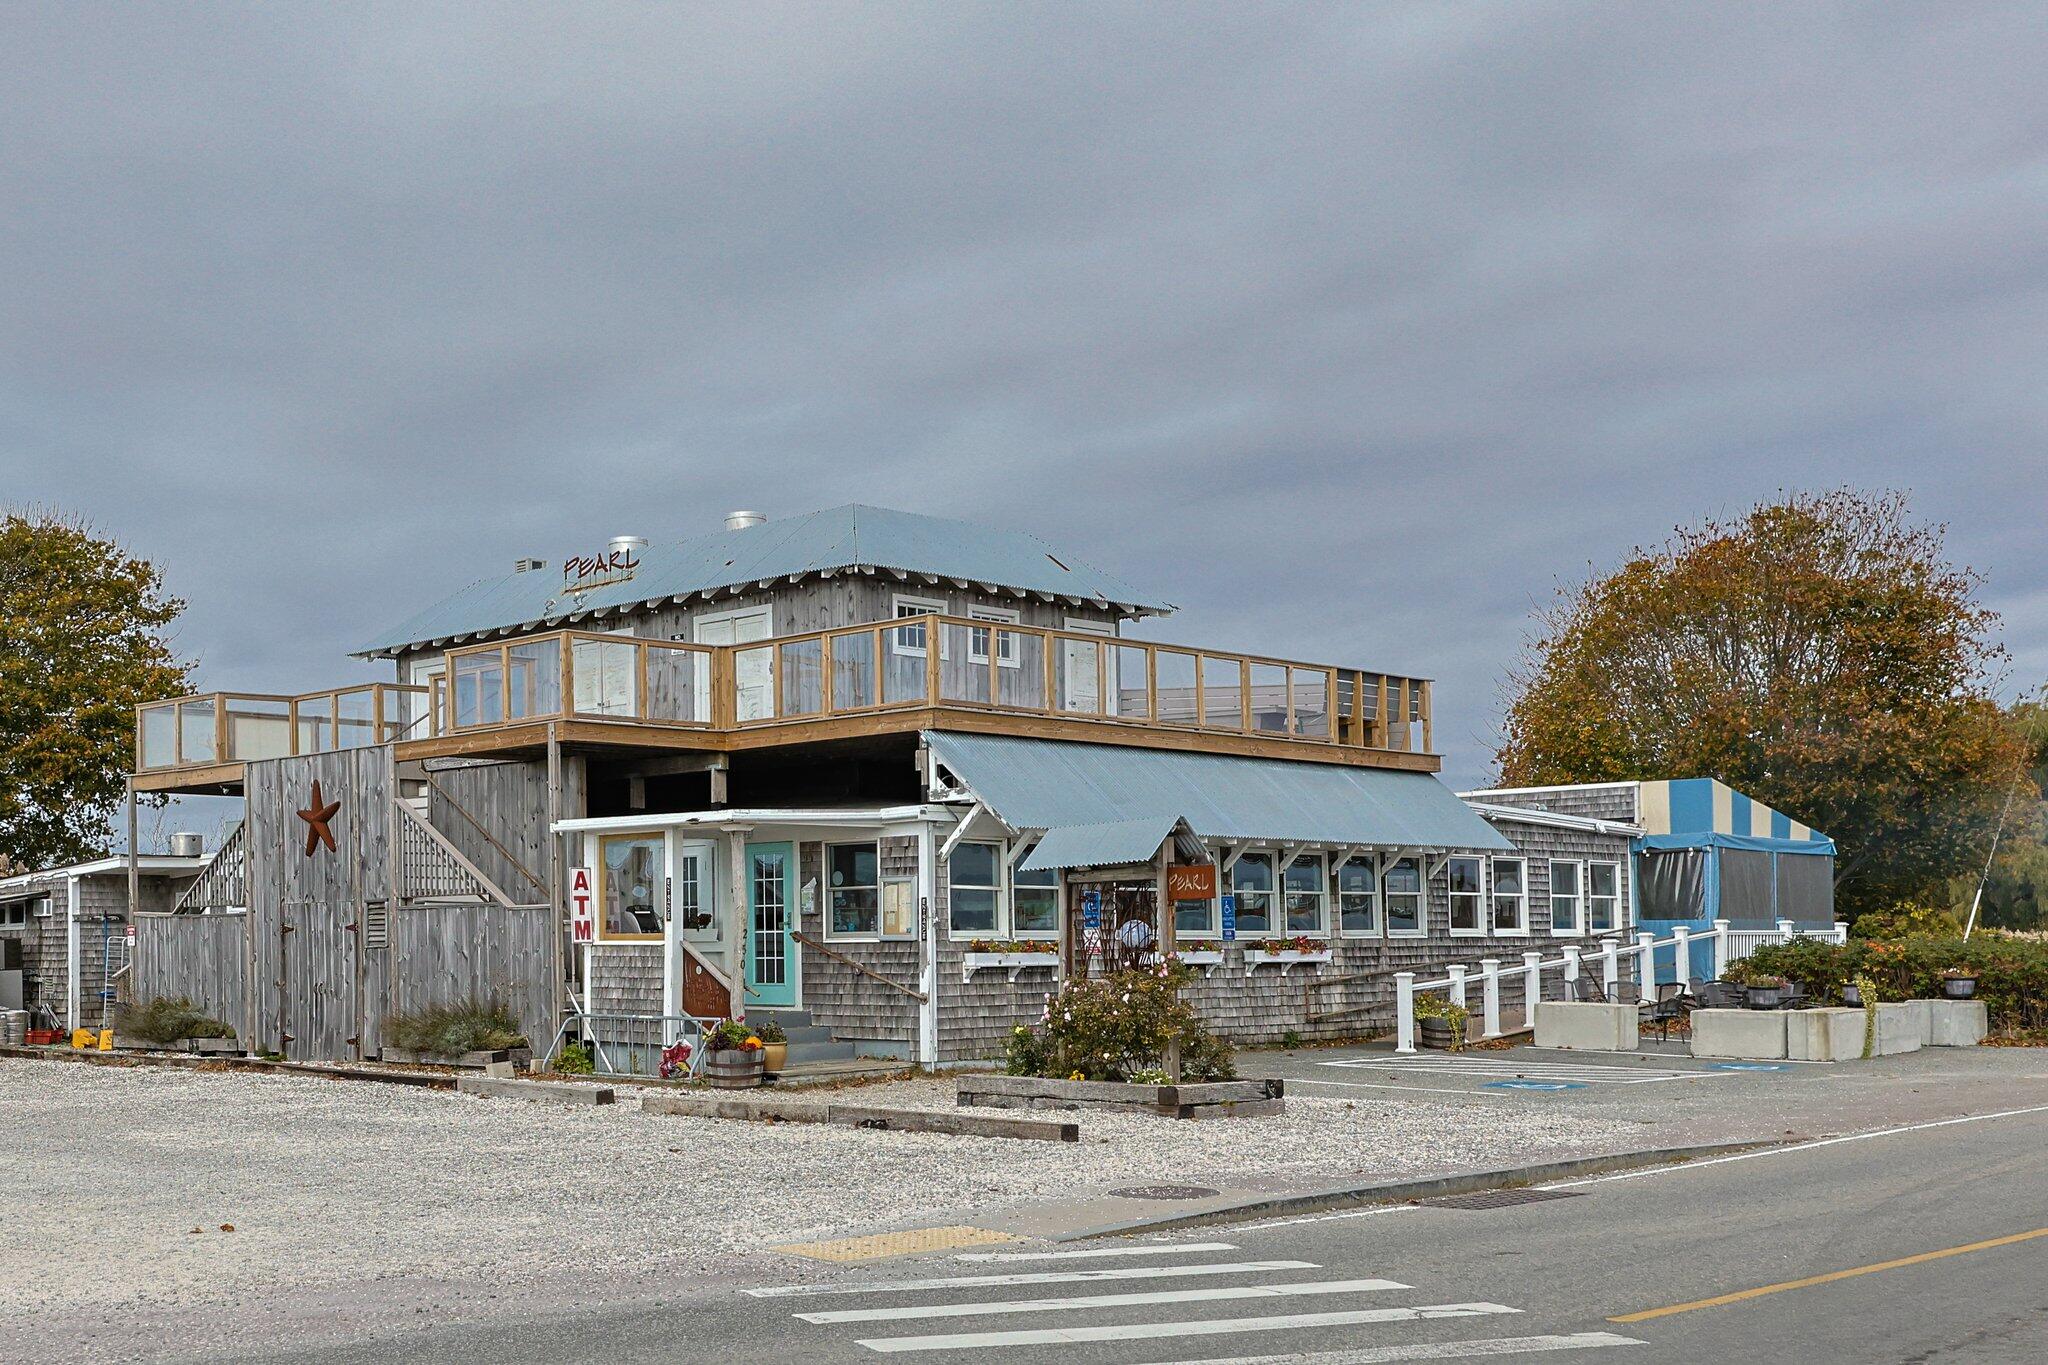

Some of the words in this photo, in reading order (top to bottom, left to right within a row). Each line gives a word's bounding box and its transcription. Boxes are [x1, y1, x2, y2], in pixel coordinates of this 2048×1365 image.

[564, 548, 640, 579] PEARL
[1168, 873, 1209, 891] PEARL
[574, 871, 591, 940] ATM
